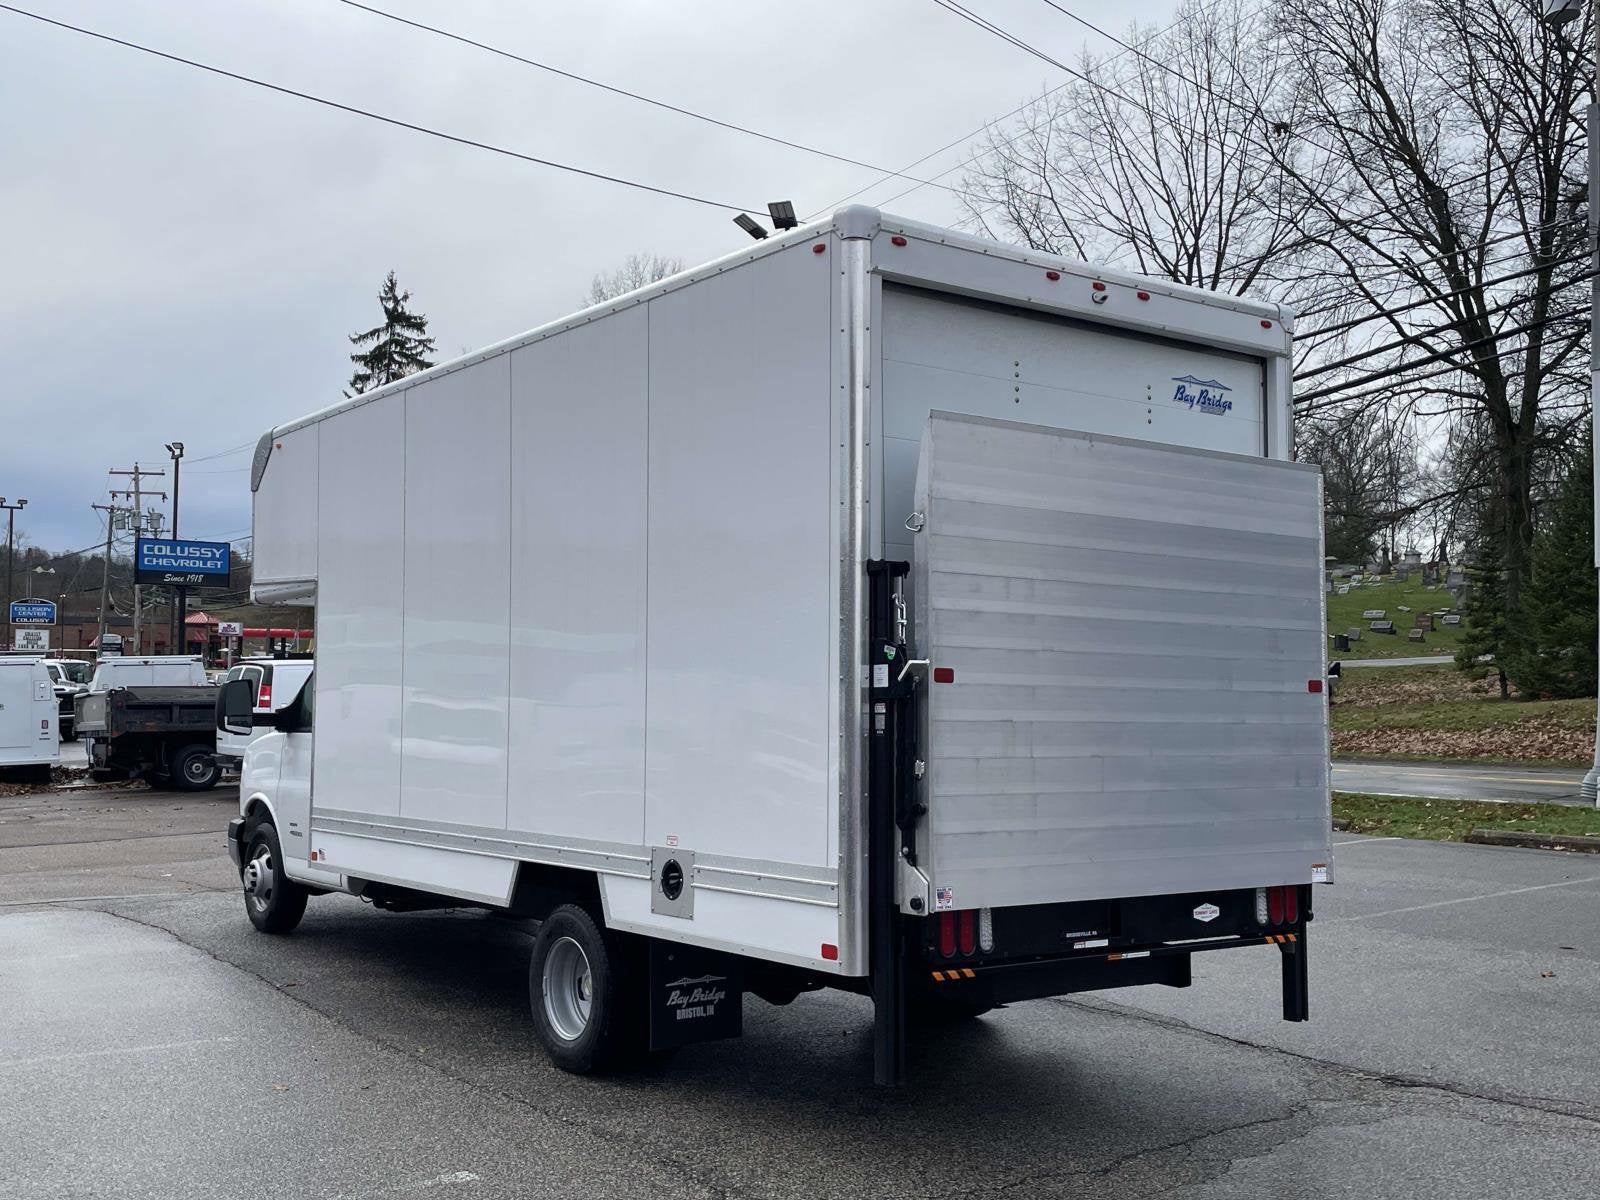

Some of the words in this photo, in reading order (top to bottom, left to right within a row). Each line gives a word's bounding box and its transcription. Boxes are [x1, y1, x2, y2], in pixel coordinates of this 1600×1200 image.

[1173, 384, 1196, 409] Bay
[1196, 389, 1232, 413] Bridge
[143, 544, 225, 559] COLUSSY
[144, 557, 224, 569] CHEVROLET
[163, 573, 185, 582] Since
[186, 574, 204, 583] 1918
[666, 990, 689, 1008] Bay
[689, 987, 725, 1004] Bridge
[676, 1006, 706, 1020] BRISTOL,
[706, 1004, 715, 1016] IN
